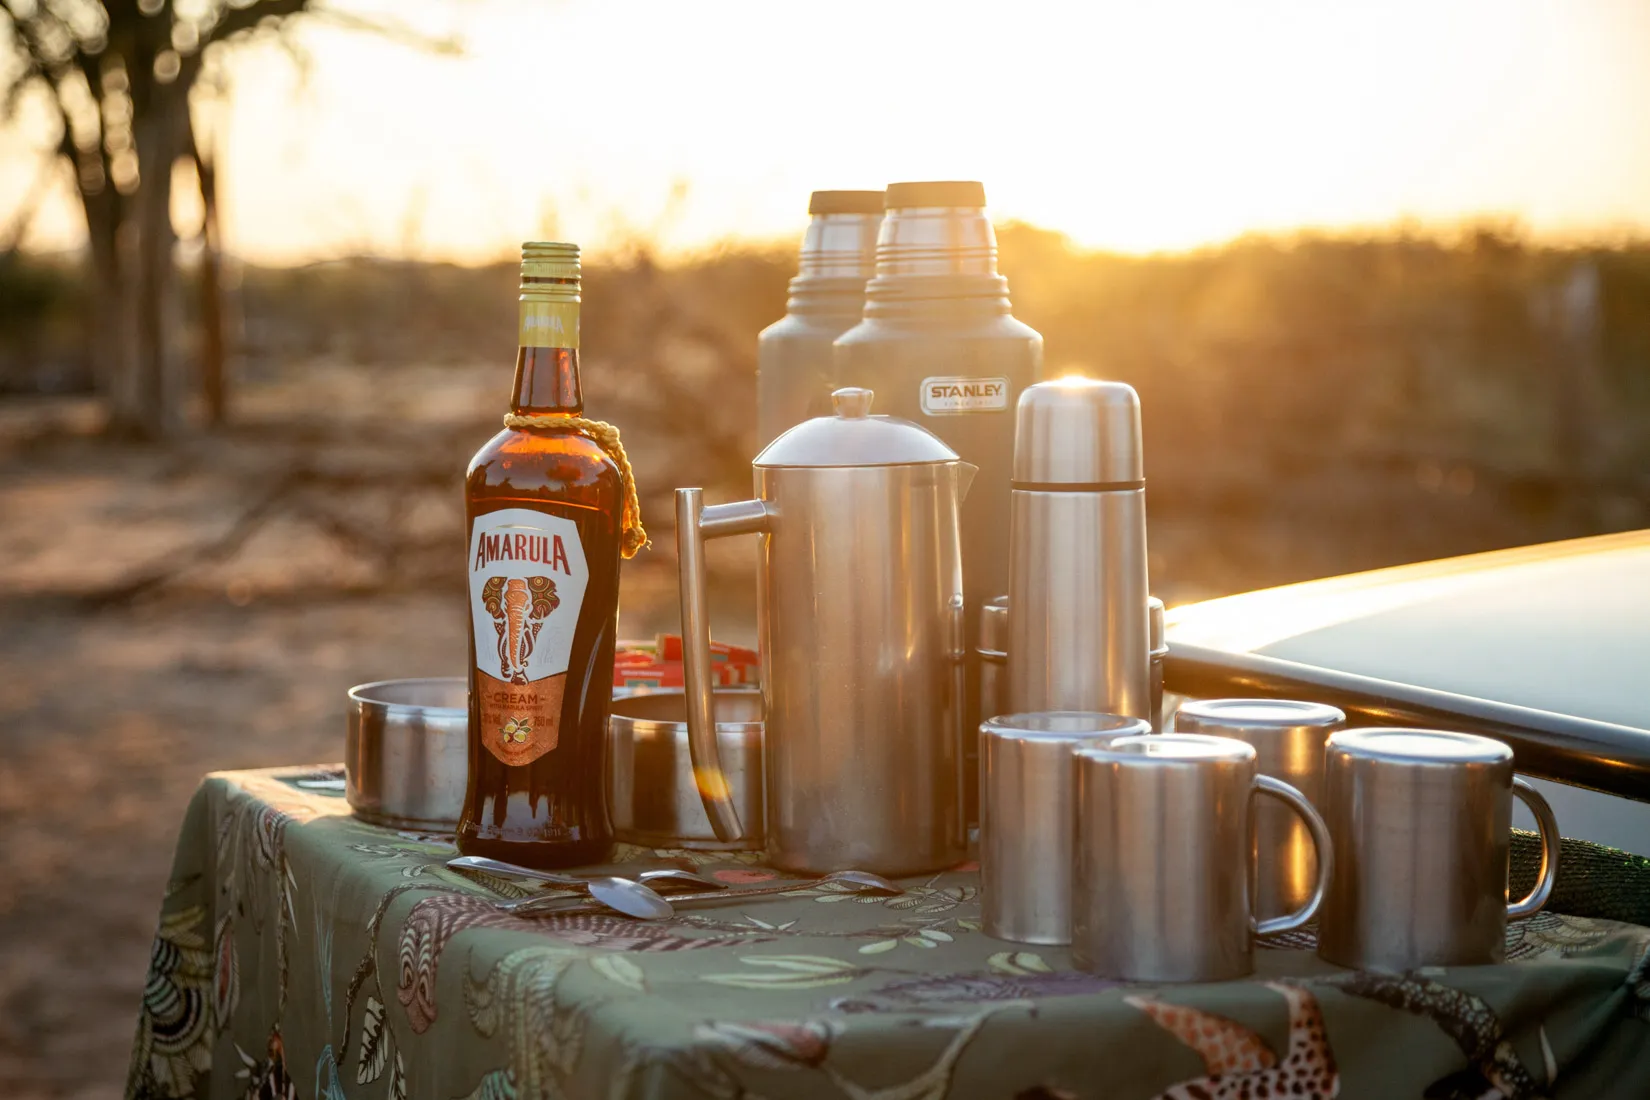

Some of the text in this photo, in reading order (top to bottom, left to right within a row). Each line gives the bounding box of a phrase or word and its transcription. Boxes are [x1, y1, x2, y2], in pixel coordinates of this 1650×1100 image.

[931, 384, 1001, 398] STANLEY
[475, 532, 571, 576] AMARULA
[493, 693, 538, 704] CREAM
